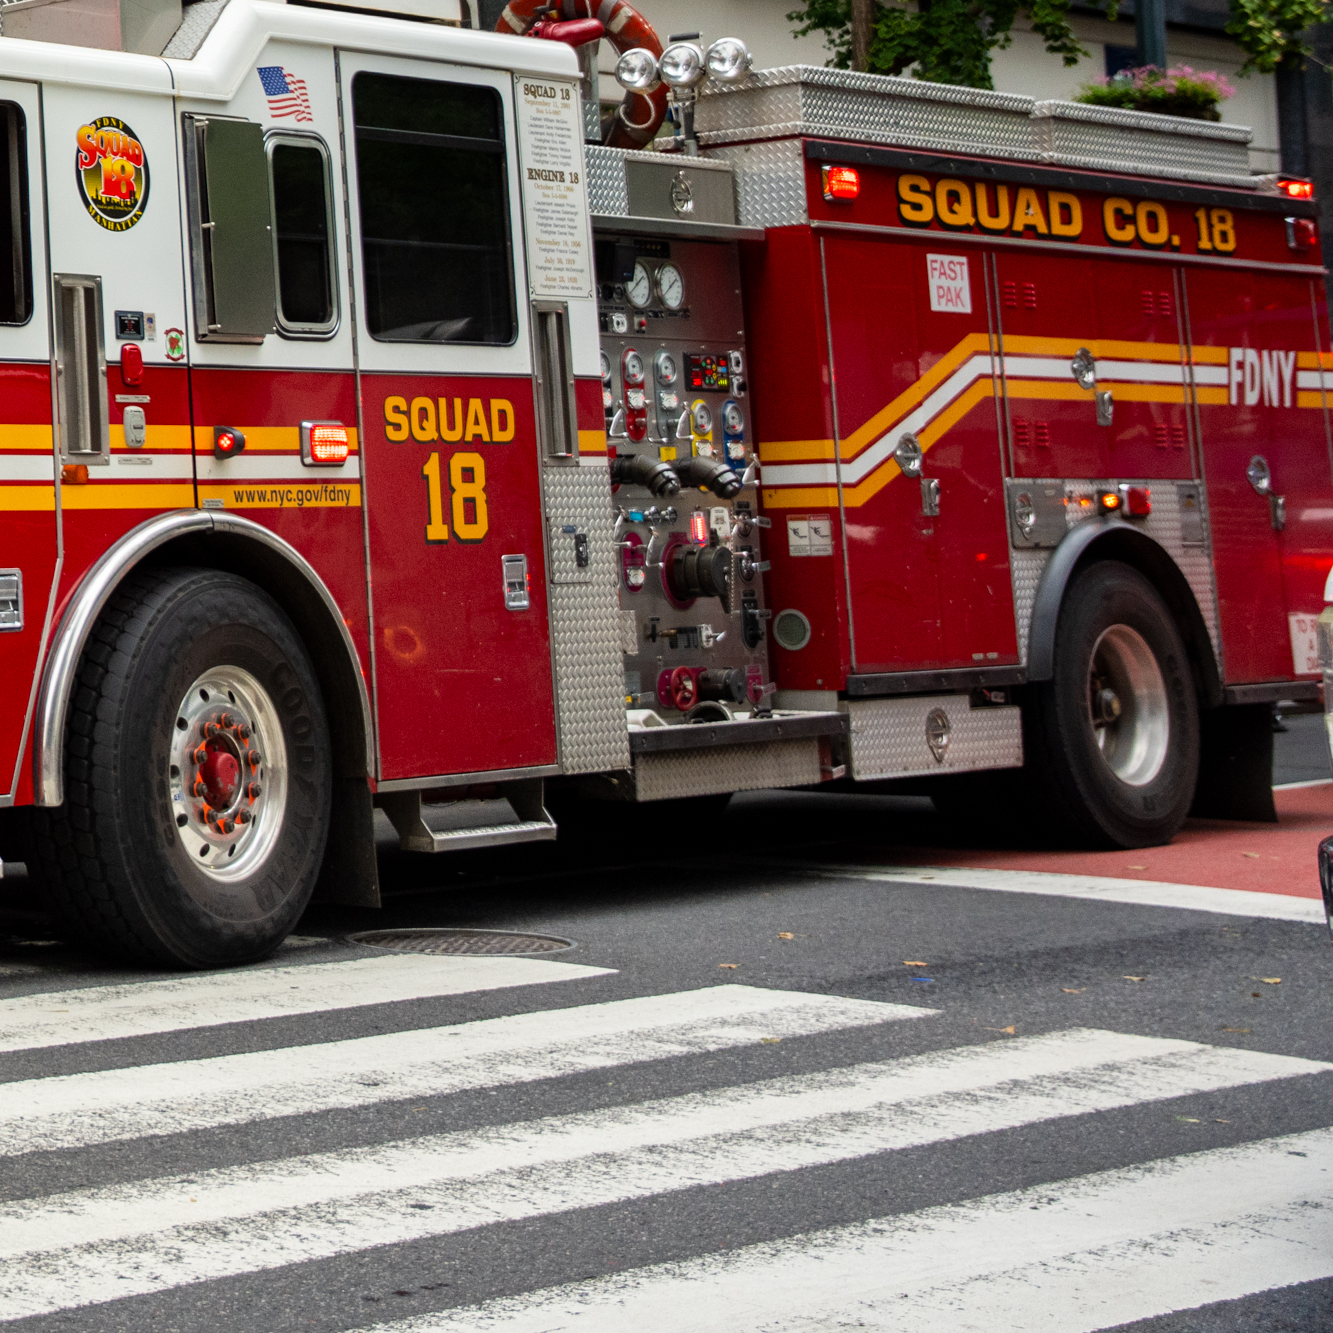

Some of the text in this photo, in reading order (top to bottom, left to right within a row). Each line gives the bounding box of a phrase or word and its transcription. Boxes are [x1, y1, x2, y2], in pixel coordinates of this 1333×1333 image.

[523, 84, 570, 100] SQUAD 18
[96, 117, 124, 129] FDNY
[77, 124, 143, 170] SQUAD
[100, 155, 136, 201] 18
[527, 168, 579, 184] ENGINE 18
[534, 182, 554, 190] October
[88, 205, 143, 231] MANHATTAN
[897, 174, 1236, 253] SQUAD CO. 18
[929, 259, 965, 282] FAST
[936, 285, 965, 308] PAK
[1230, 347, 1296, 408] FDNY
[384, 396, 515, 444] SQUAD
[234, 485, 351, 506] www.nyc.gov/fdny
[421, 452, 488, 545] 18
